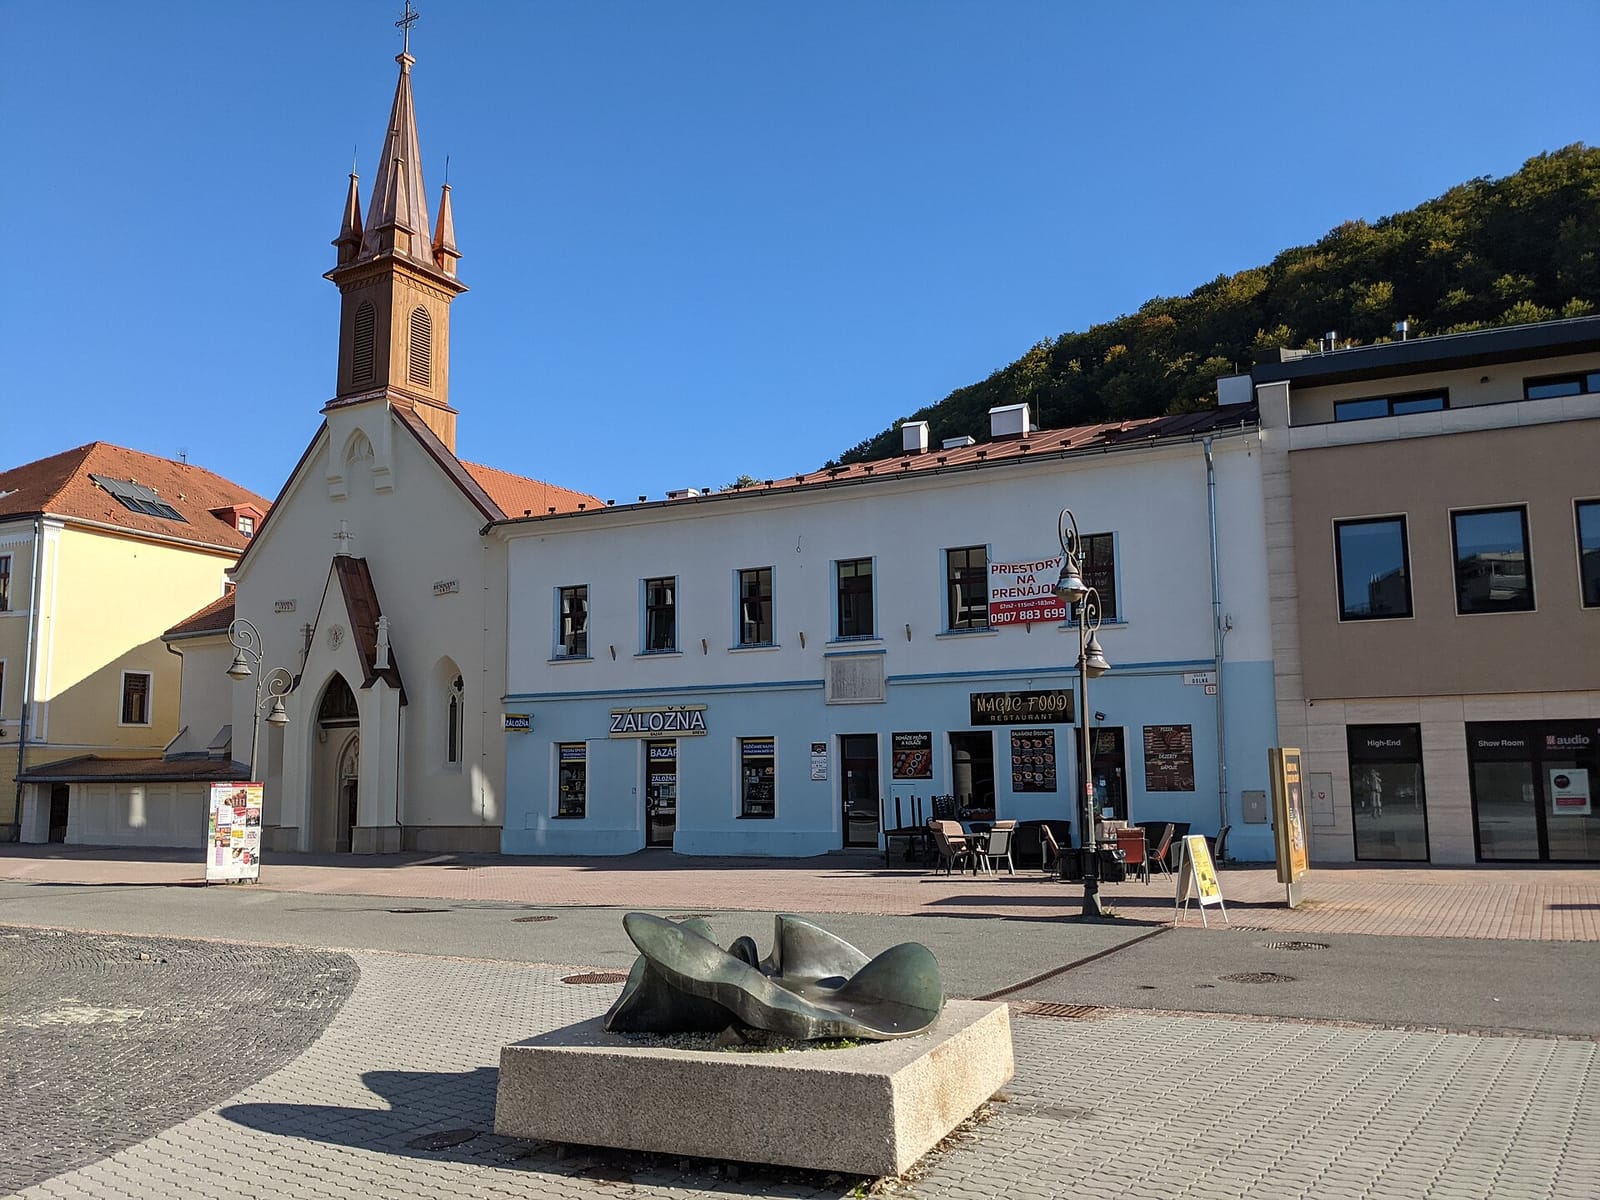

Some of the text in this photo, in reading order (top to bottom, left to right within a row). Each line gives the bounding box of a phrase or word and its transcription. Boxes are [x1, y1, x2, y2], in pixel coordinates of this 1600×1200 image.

[991, 558, 1062, 574] PRIESTORY
[1016, 574, 1036, 585] NA
[991, 607, 1066, 623] 0907 883 699
[977, 694, 1067, 714] MAGIC FOOD
[610, 706, 706, 732] ZÁLOŽŇA
[990, 713, 1053, 721] RESTAURANT
[1367, 739, 1401, 747] High-End
[1478, 738, 1524, 748] Show Room
[1556, 734, 1590, 745] audio
